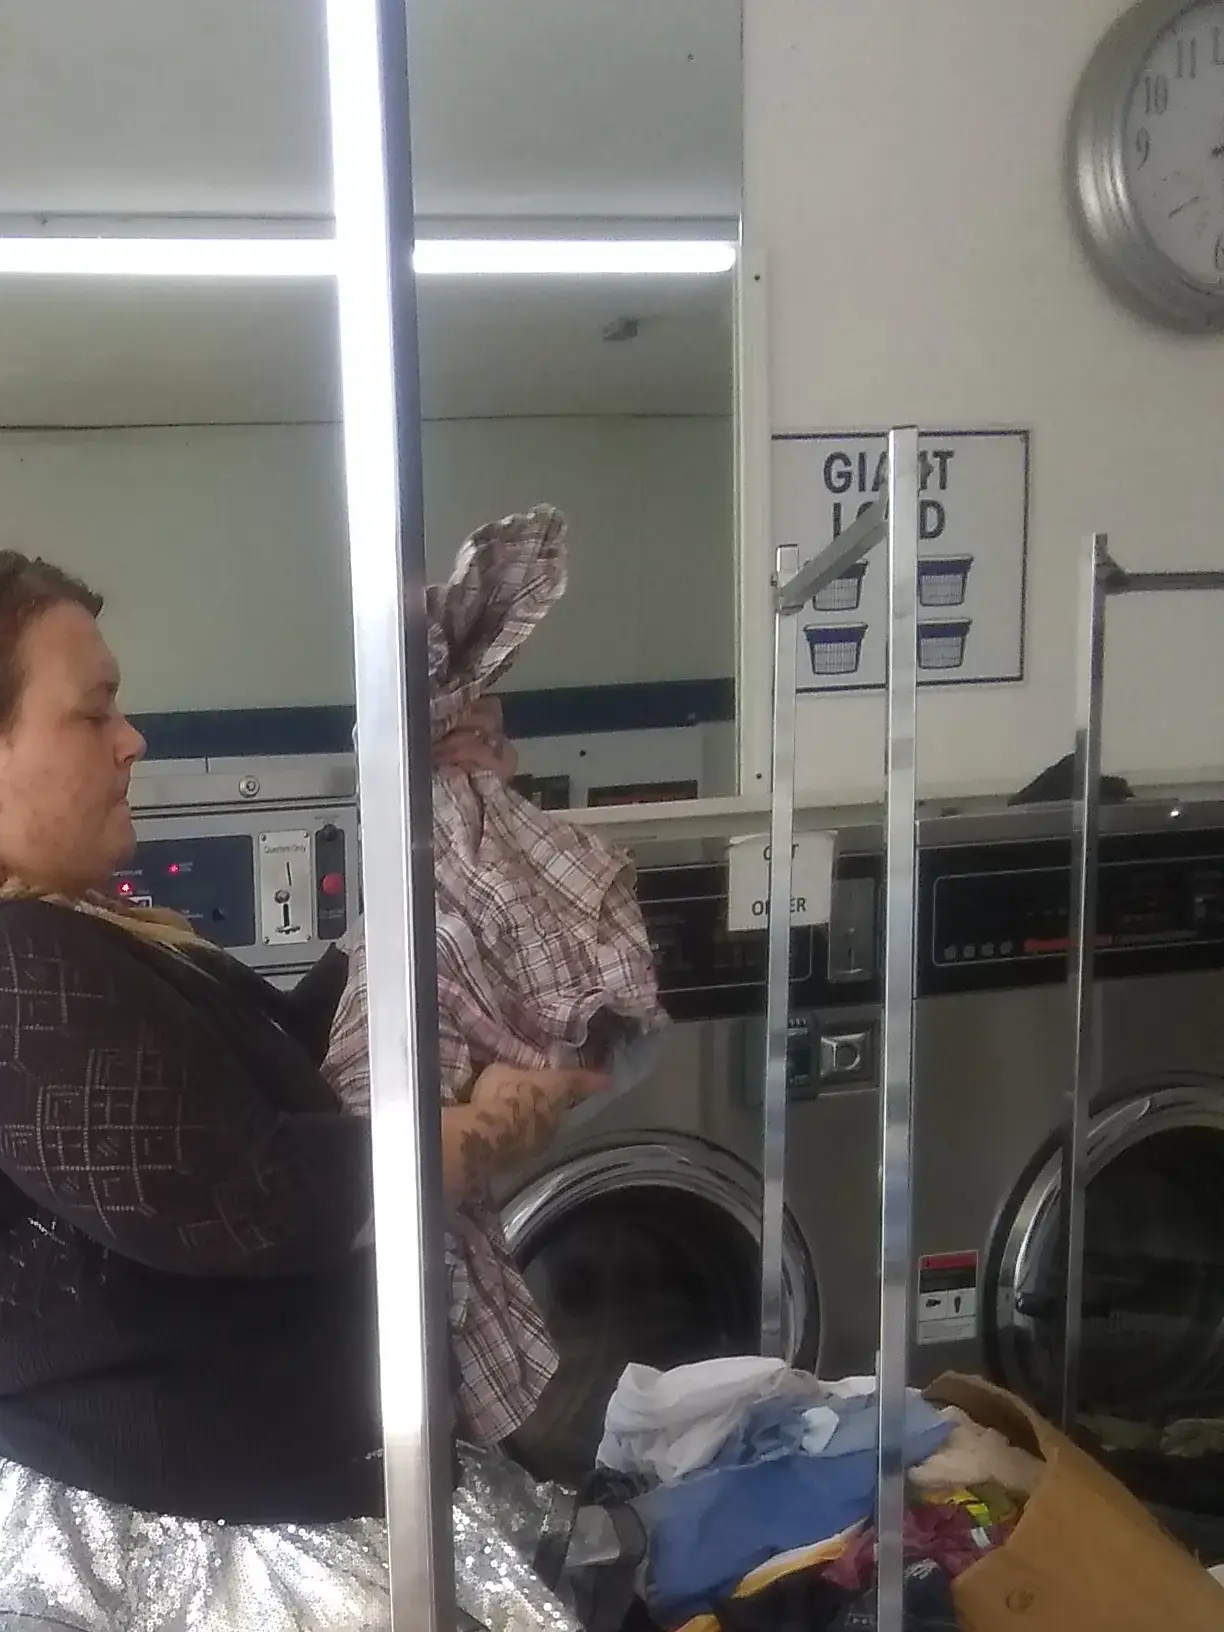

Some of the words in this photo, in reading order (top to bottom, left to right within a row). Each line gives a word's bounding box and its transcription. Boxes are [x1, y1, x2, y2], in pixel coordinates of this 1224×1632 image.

[1143, 74, 1169, 115] 10
[823, 450, 954, 493] GIT
[763, 844, 799, 861] OT
[751, 897, 807, 916] OER
